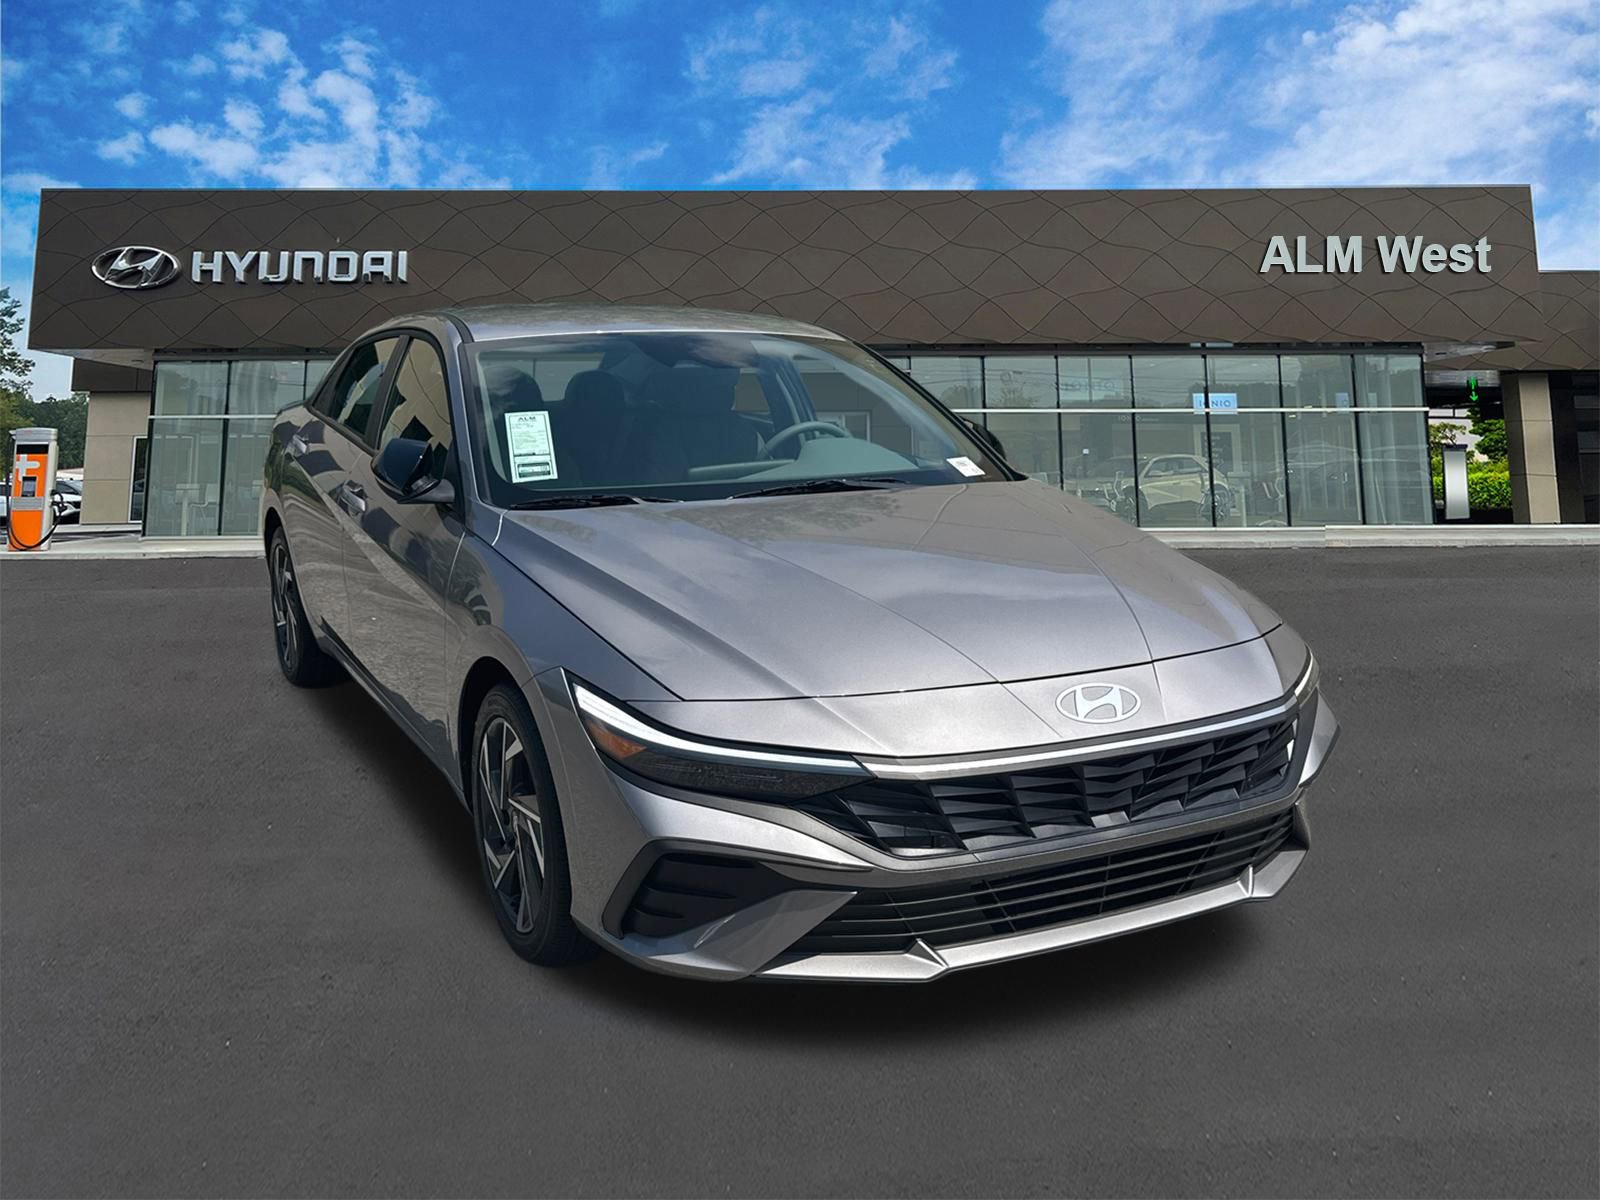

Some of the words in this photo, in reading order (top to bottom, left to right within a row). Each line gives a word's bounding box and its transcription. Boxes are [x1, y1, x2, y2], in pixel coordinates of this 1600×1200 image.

[191, 250, 408, 283] HYUNDAI
[1260, 235, 1363, 273] ALM
[1377, 235, 1492, 273] West
